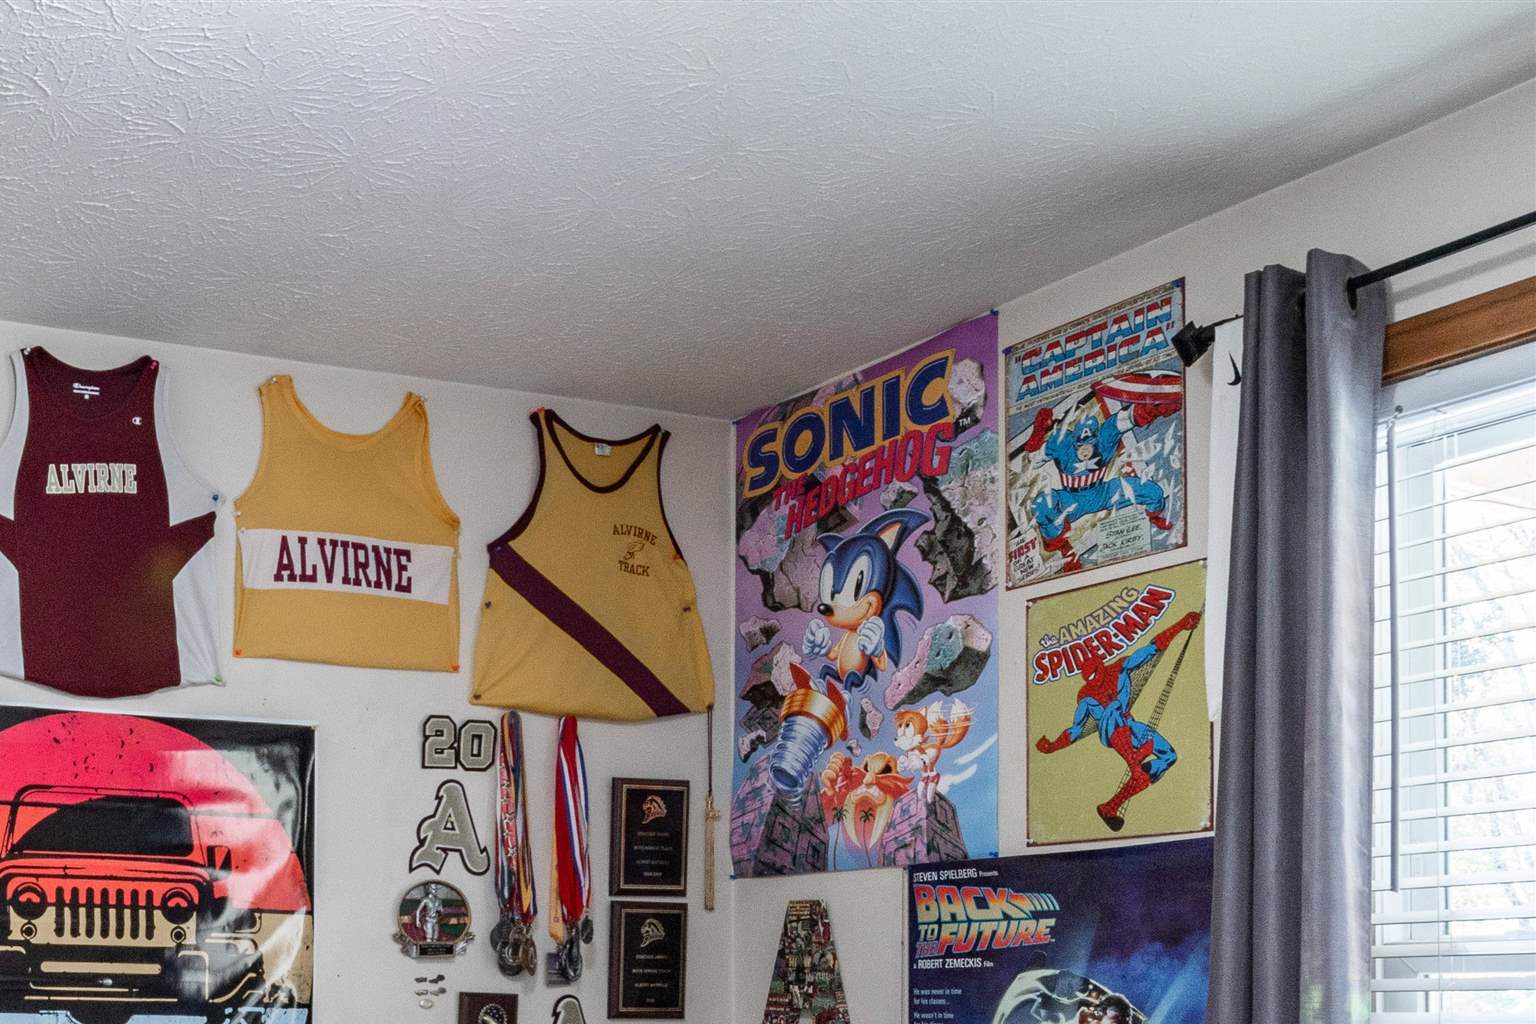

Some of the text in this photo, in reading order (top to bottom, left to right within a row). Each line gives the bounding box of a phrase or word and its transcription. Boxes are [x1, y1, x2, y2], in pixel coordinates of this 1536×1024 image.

[745, 351, 954, 496] SONIC
[45, 462, 139, 495] ALVIRNE
[773, 472, 808, 512] THE
[784, 422, 955, 541] HEDGEHOG
[613, 524, 657, 546] ALVIRNE
[273, 534, 413, 594] ALVIRNE
[617, 560, 650, 577] TRACK
[1039, 587, 1140, 647] the AMAZING
[422, 714, 497, 772] 20
[409, 779, 490, 875] A
[913, 872, 938, 882] STEVEN
[939, 869, 978, 881] SPIELBERG
[913, 884, 1040, 923] BACK
[918, 923, 939, 941] TO
[938, 918, 1057, 956] FUTURE
[918, 959, 943, 969] ROBERT
[945, 958, 982, 968] ZEMECKIS
